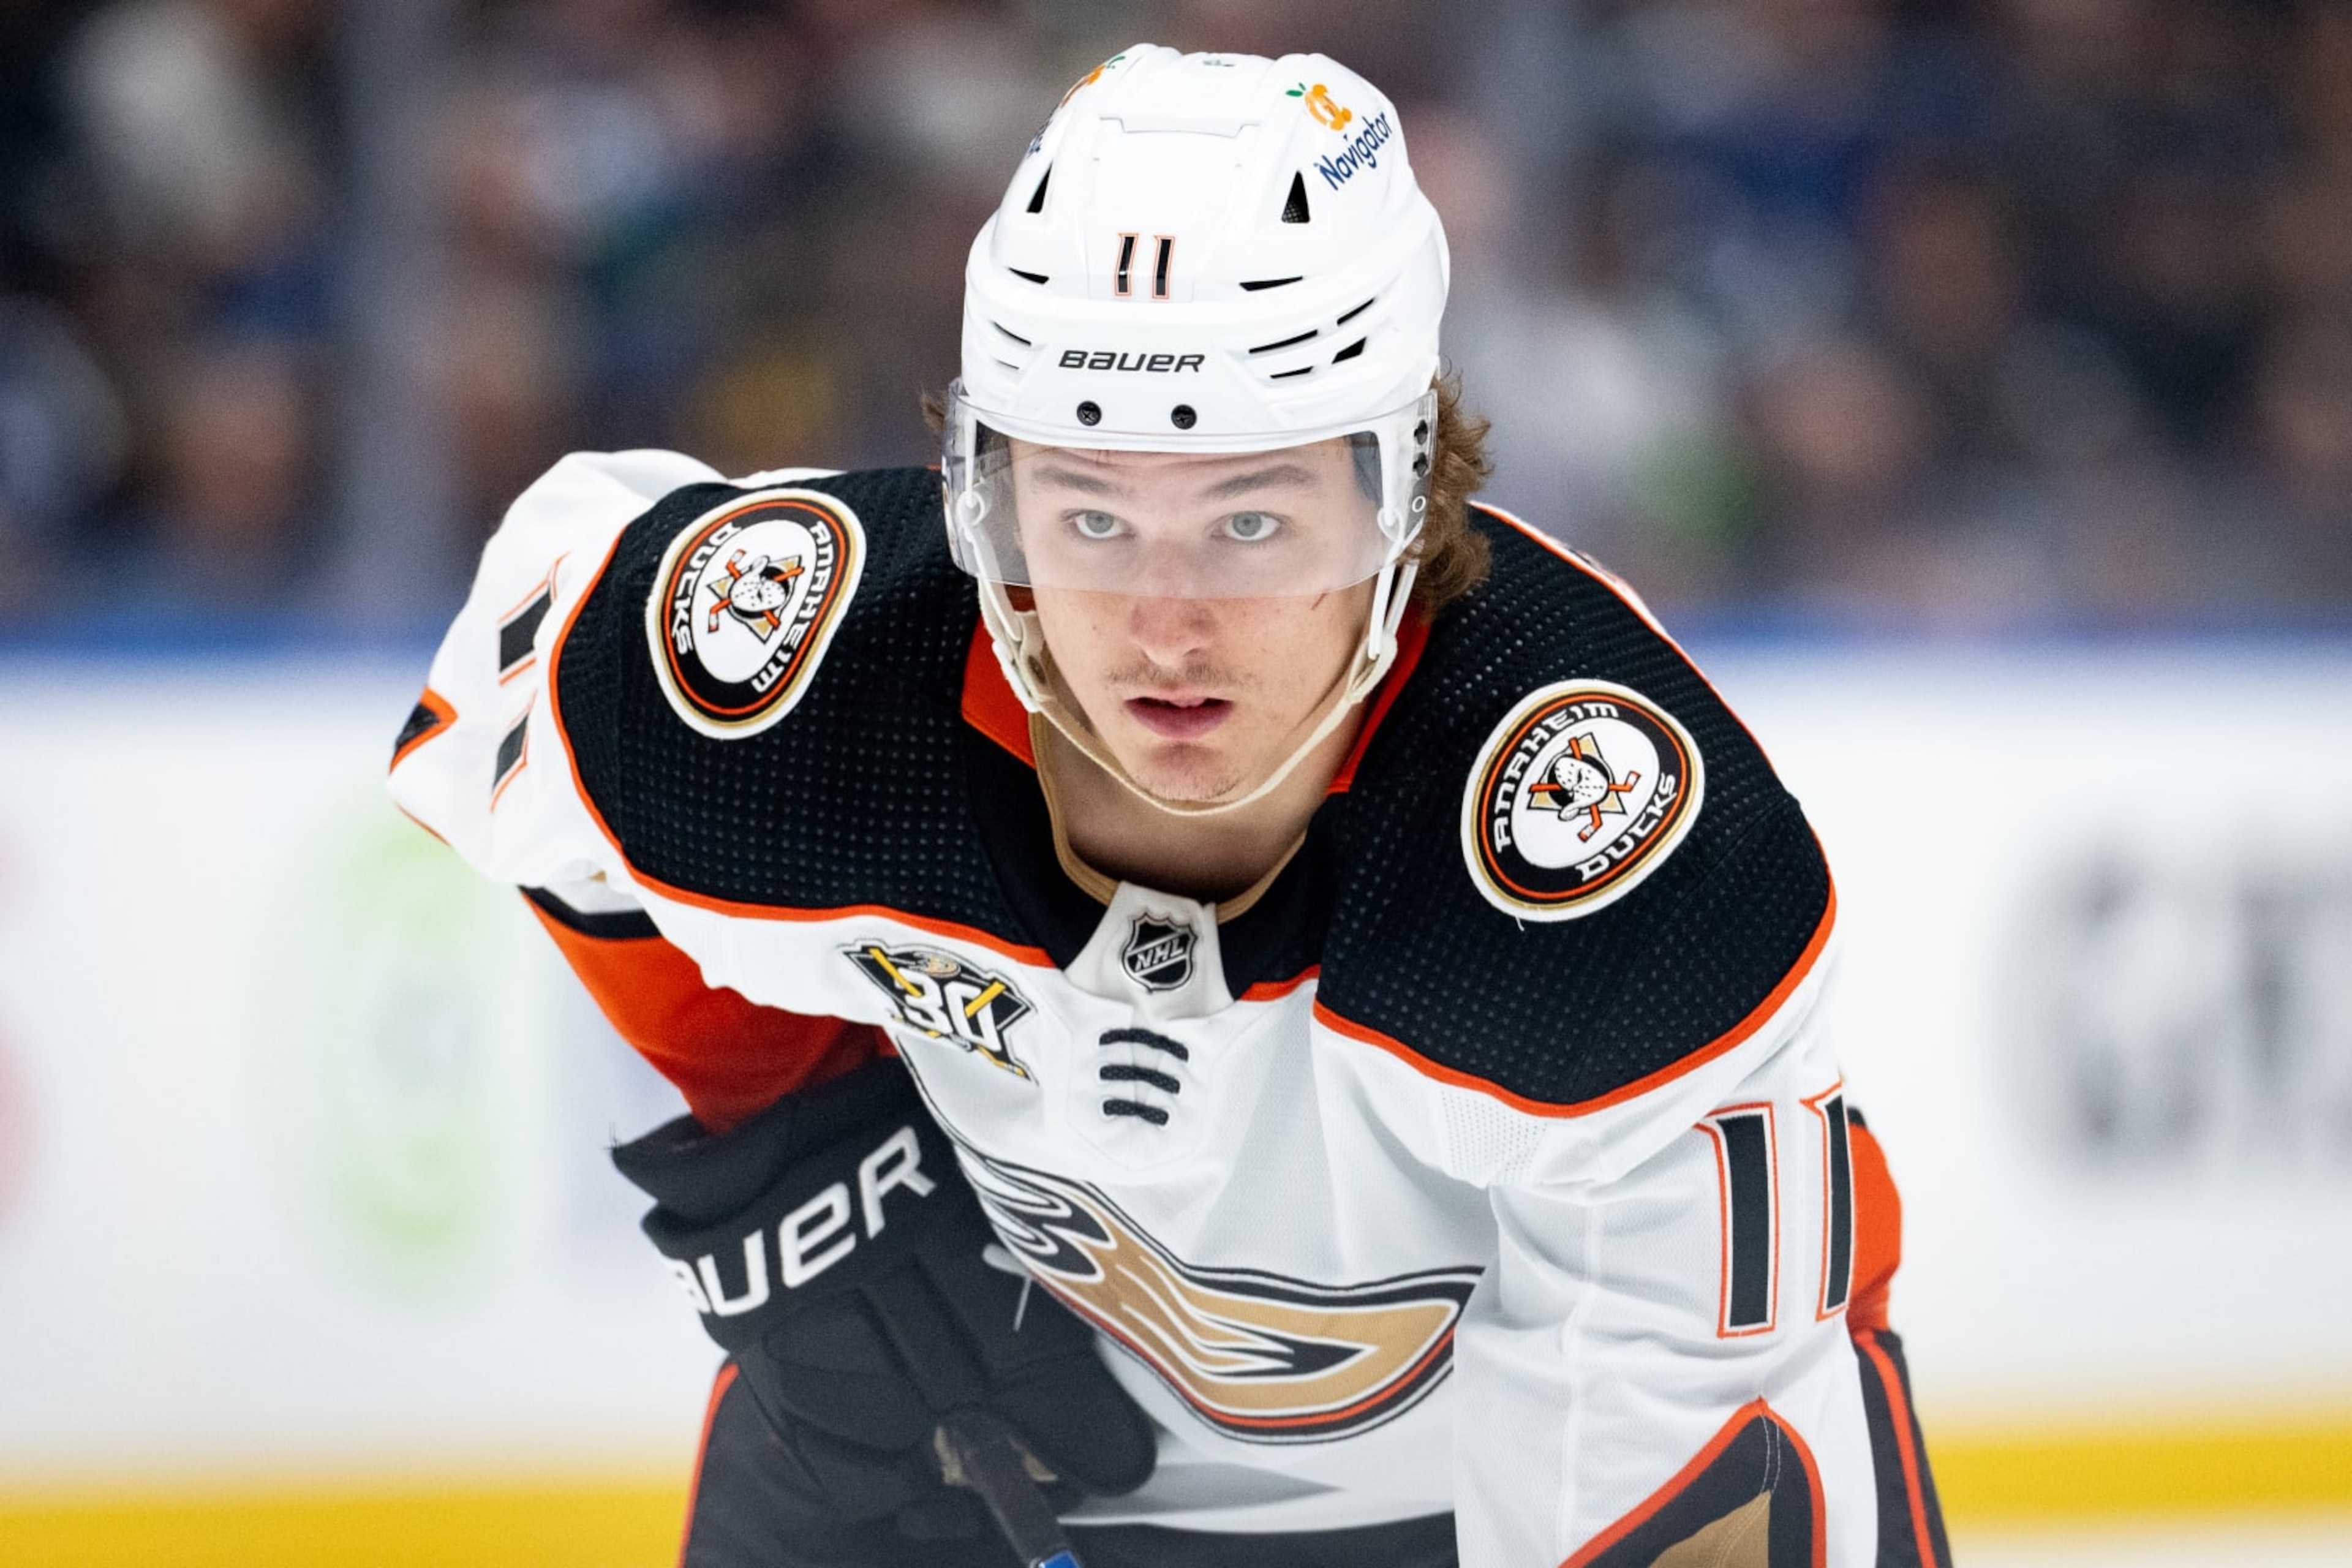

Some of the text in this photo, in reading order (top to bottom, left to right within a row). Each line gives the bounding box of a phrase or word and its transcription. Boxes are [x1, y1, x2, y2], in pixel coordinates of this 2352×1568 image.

[1314, 111, 1392, 190] Navigator
[1114, 233, 1175, 300] 11
[671, 522, 742, 655] DUCKS
[751, 520, 834, 693] ANAHEIM
[1494, 703, 1619, 853] ANAHEIM
[1575, 772, 1677, 882] DUCKS
[894, 967, 1003, 1052] 30
[1134, 938, 1185, 971] NHL
[1693, 1081, 1854, 1339] 11
